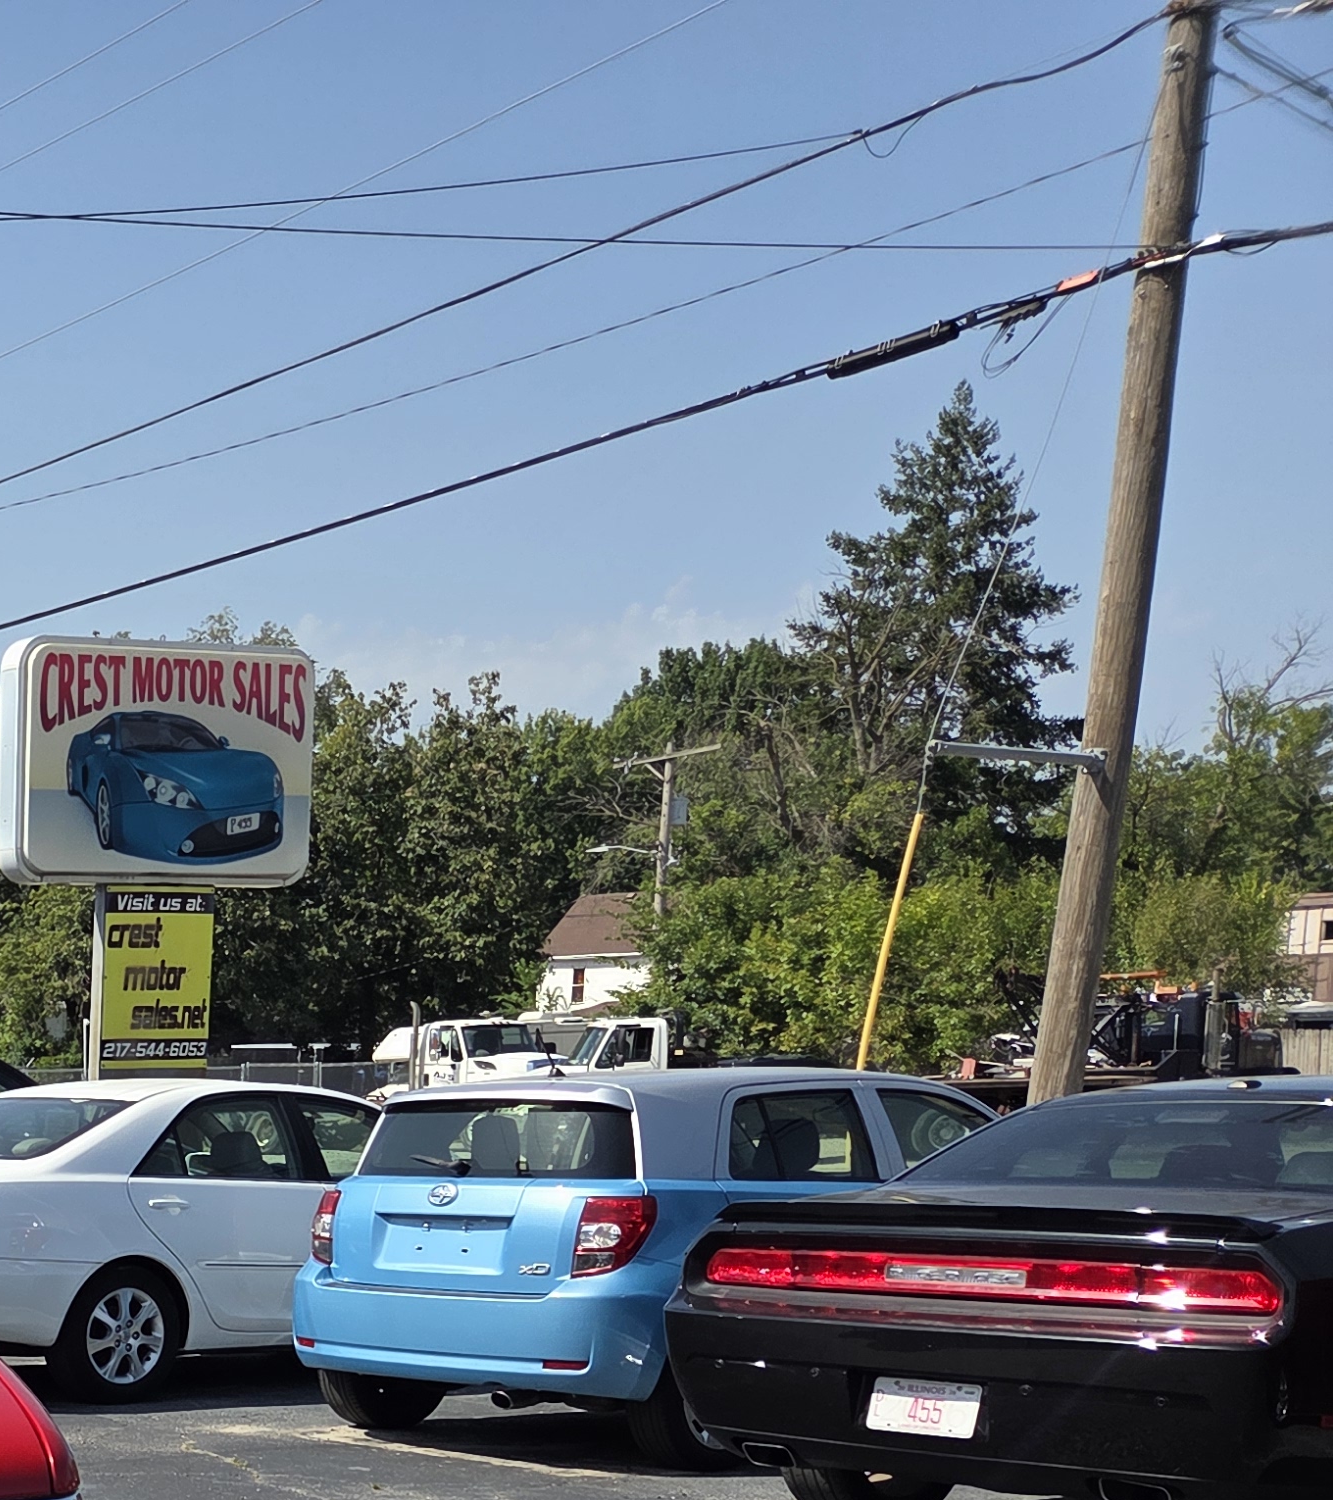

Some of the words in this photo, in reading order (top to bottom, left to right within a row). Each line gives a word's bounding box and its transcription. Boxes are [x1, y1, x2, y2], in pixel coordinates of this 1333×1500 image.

[39, 652, 127, 733] CREST
[132, 656, 226, 708] MOTOR
[232, 660, 307, 743] SALES
[117, 894, 154, 911] Visit
[159, 898, 182, 911] us
[185, 895, 206, 911] at:
[107, 917, 163, 949] crest
[123, 959, 187, 991] motor
[130, 998, 207, 1030] sales.net
[102, 1042, 207, 1058] 217-544-6053
[907, 1384, 947, 1395] ILLINOIS
[907, 1395, 943, 1425] 455
